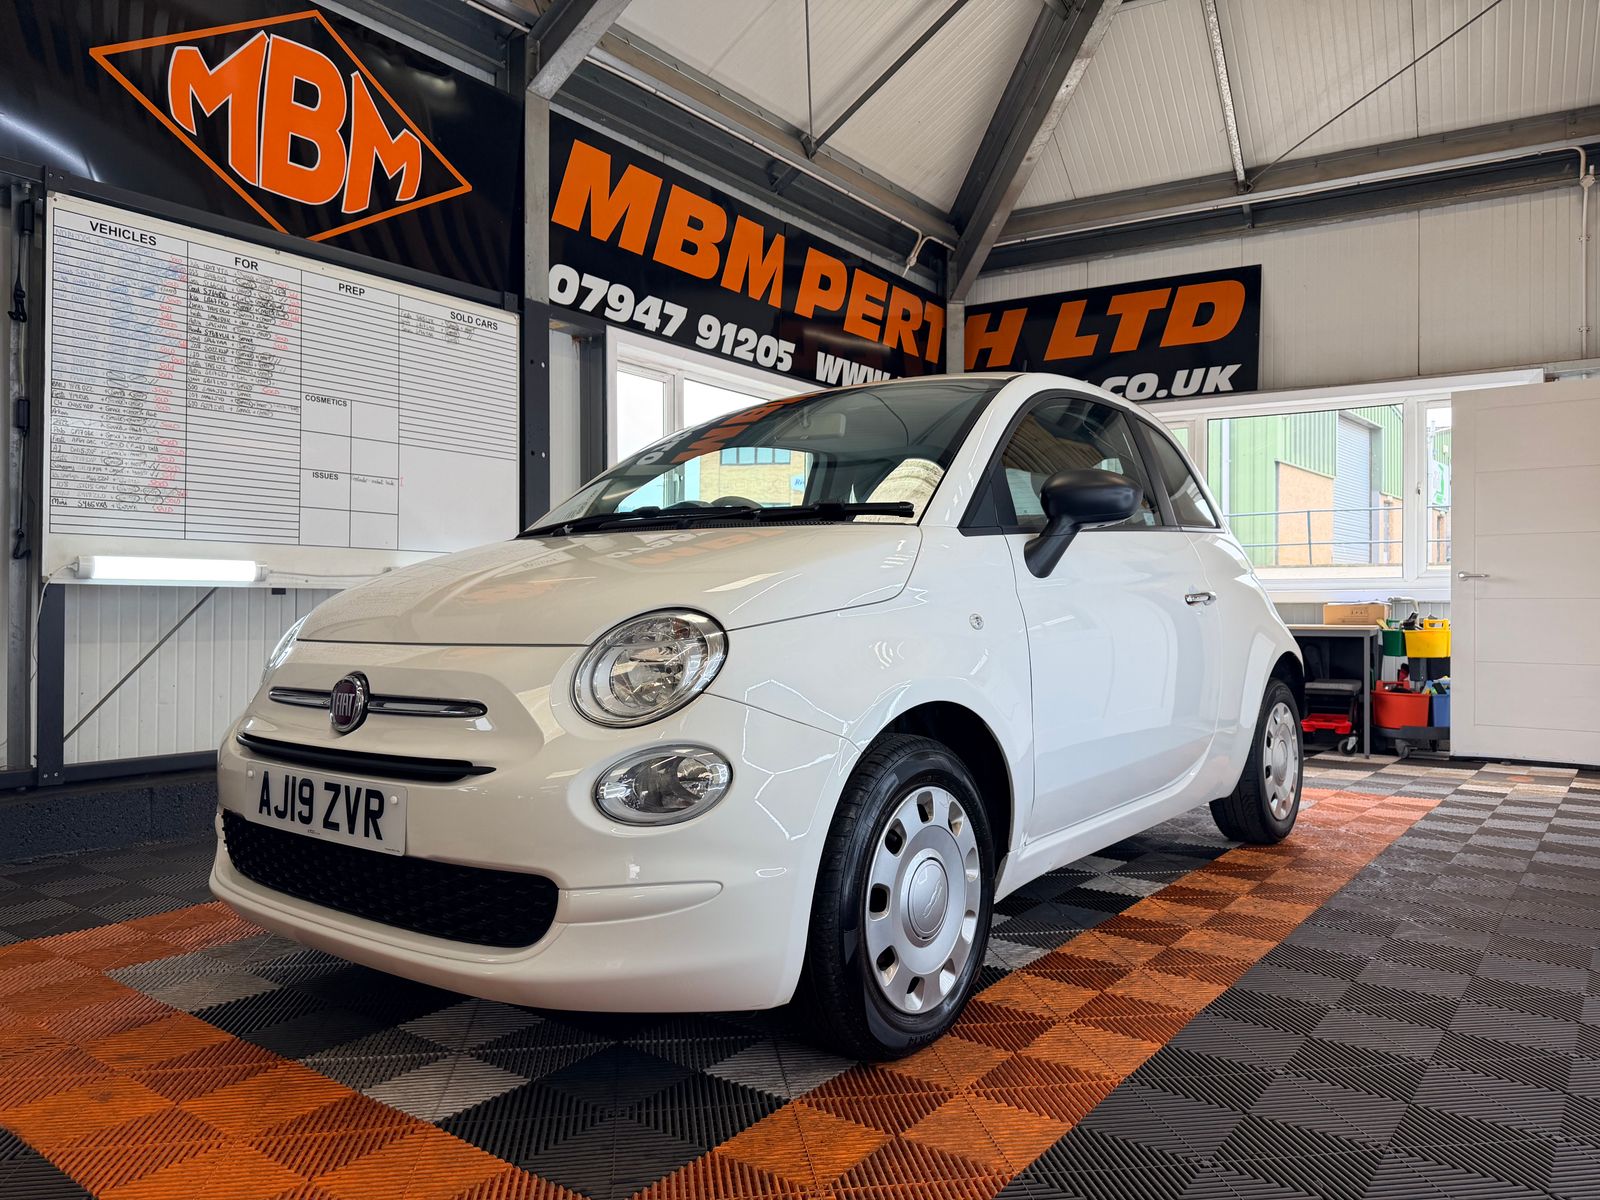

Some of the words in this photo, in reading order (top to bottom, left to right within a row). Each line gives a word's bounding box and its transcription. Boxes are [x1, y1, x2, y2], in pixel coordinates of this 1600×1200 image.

[168, 31, 422, 214] MBM
[89, 220, 157, 246] VEHICLES
[551, 139, 785, 308] MBM
[234, 256, 259, 271] FOR
[338, 282, 365, 296] PREP
[450, 311, 473, 325] SOLD
[475, 318, 498, 331] CARS
[549, 264, 688, 337] 07947
[695, 314, 795, 372] 91205
[1043, 280, 1246, 361] LTD
[305, 394, 348, 407] COSMETICS
[312, 472, 339, 481] ISSUES
[335, 692, 355, 716] FIAT
[258, 770, 315, 825] AJ19
[322, 781, 385, 841] ZVR
